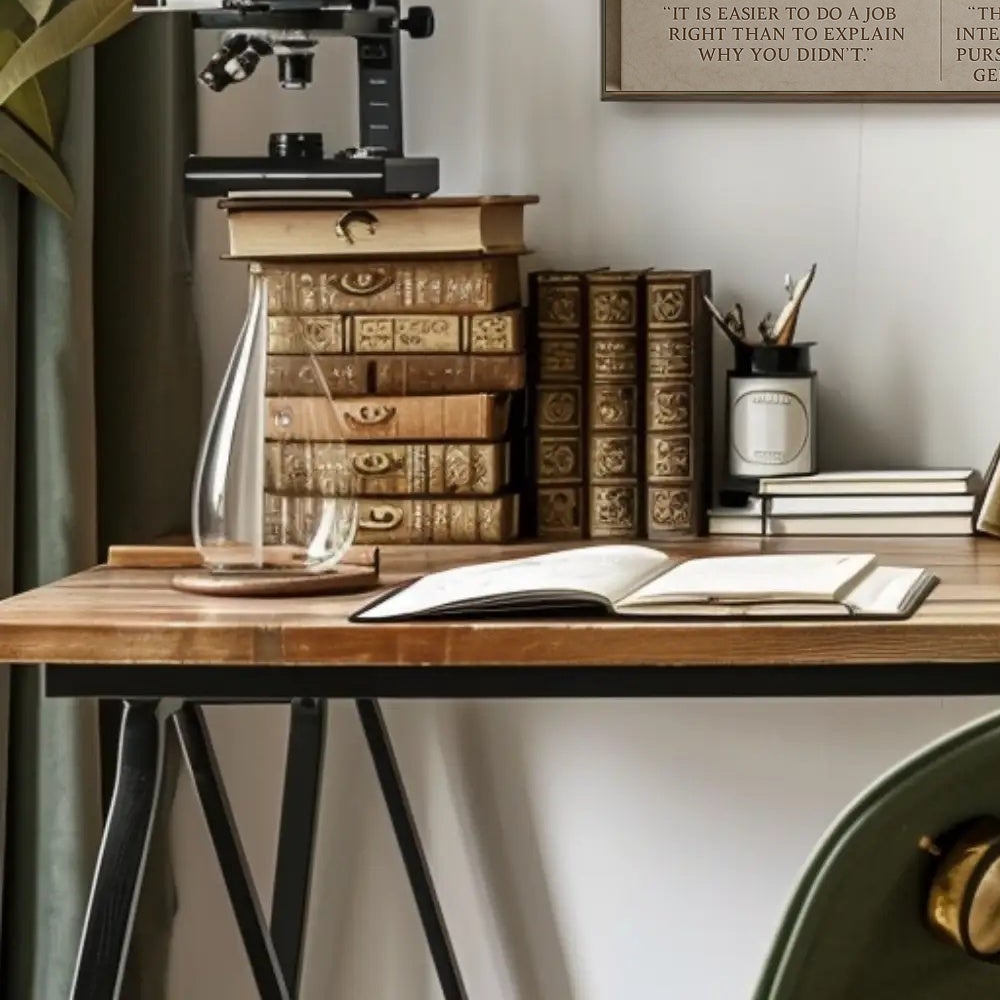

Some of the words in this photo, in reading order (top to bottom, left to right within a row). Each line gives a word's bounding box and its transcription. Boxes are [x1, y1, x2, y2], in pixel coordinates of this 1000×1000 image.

[695, 6, 712, 21] IS
[717, 6, 781, 21] EASIER
[784, 6, 810, 21] TO
[816, 6, 843, 21] DO
[847, 6, 860, 21] A
[862, 6, 897, 24] JOB
[669, 26, 727, 41] RIGHT
[731, 26, 786, 41] THAN
[791, 26, 818, 41] TO
[823, 26, 905, 41] EXPLAIN
[697, 47, 745, 62] WHY
[749, 47, 791, 62] YOU
